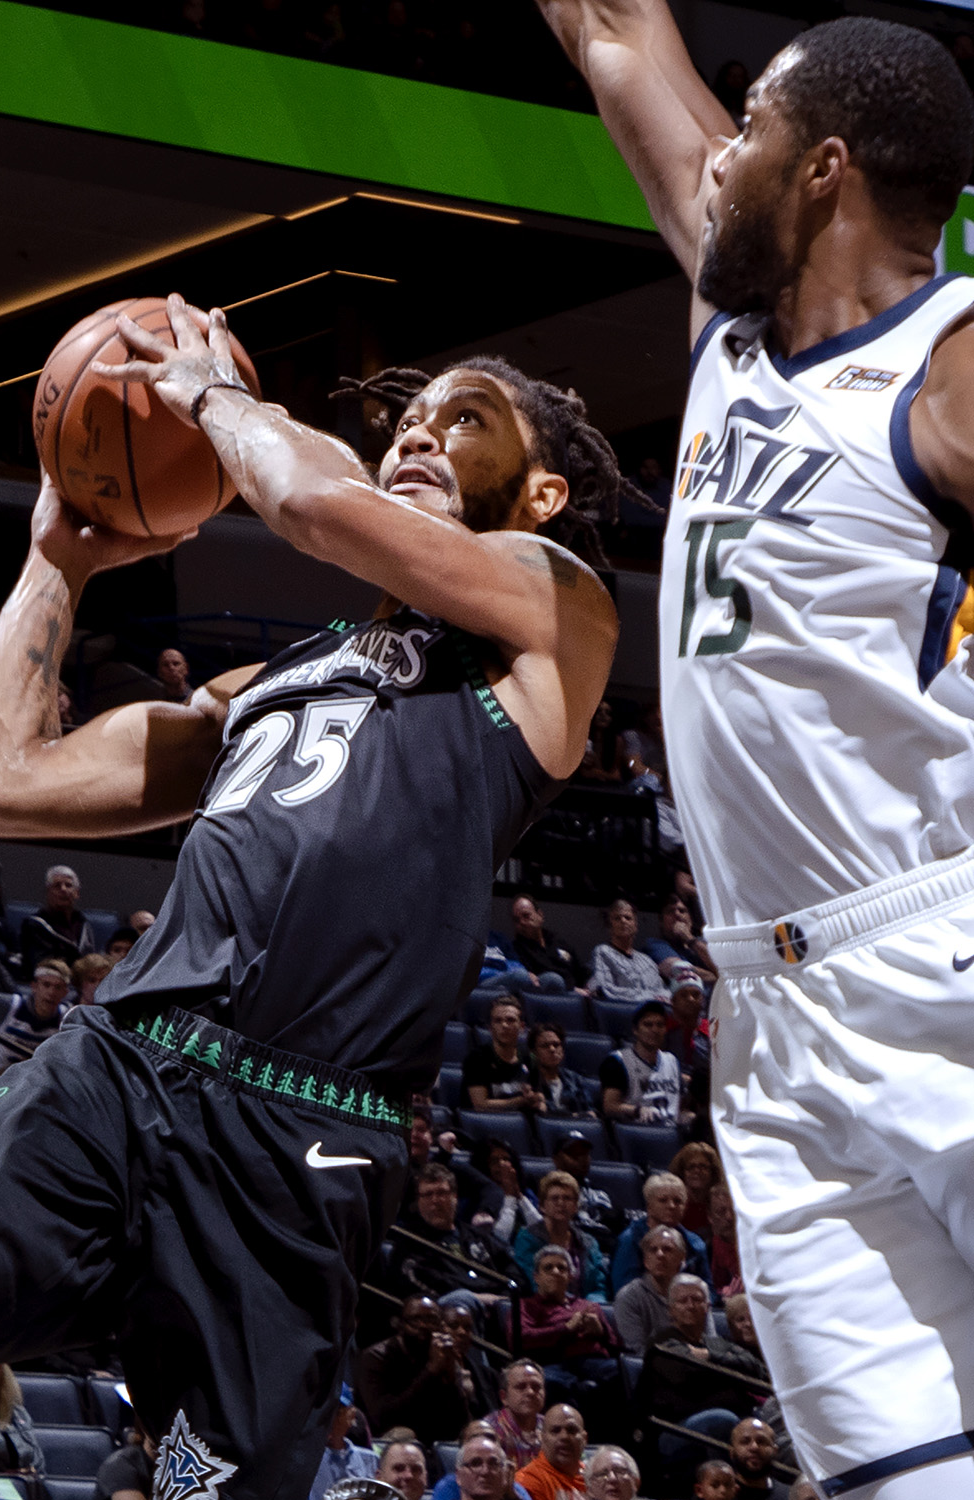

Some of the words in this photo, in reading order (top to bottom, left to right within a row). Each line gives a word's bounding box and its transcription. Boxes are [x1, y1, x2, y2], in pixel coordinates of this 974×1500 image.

[678, 398, 844, 527] JAZZ
[678, 518, 759, 658] 15
[203, 695, 378, 817] 25
